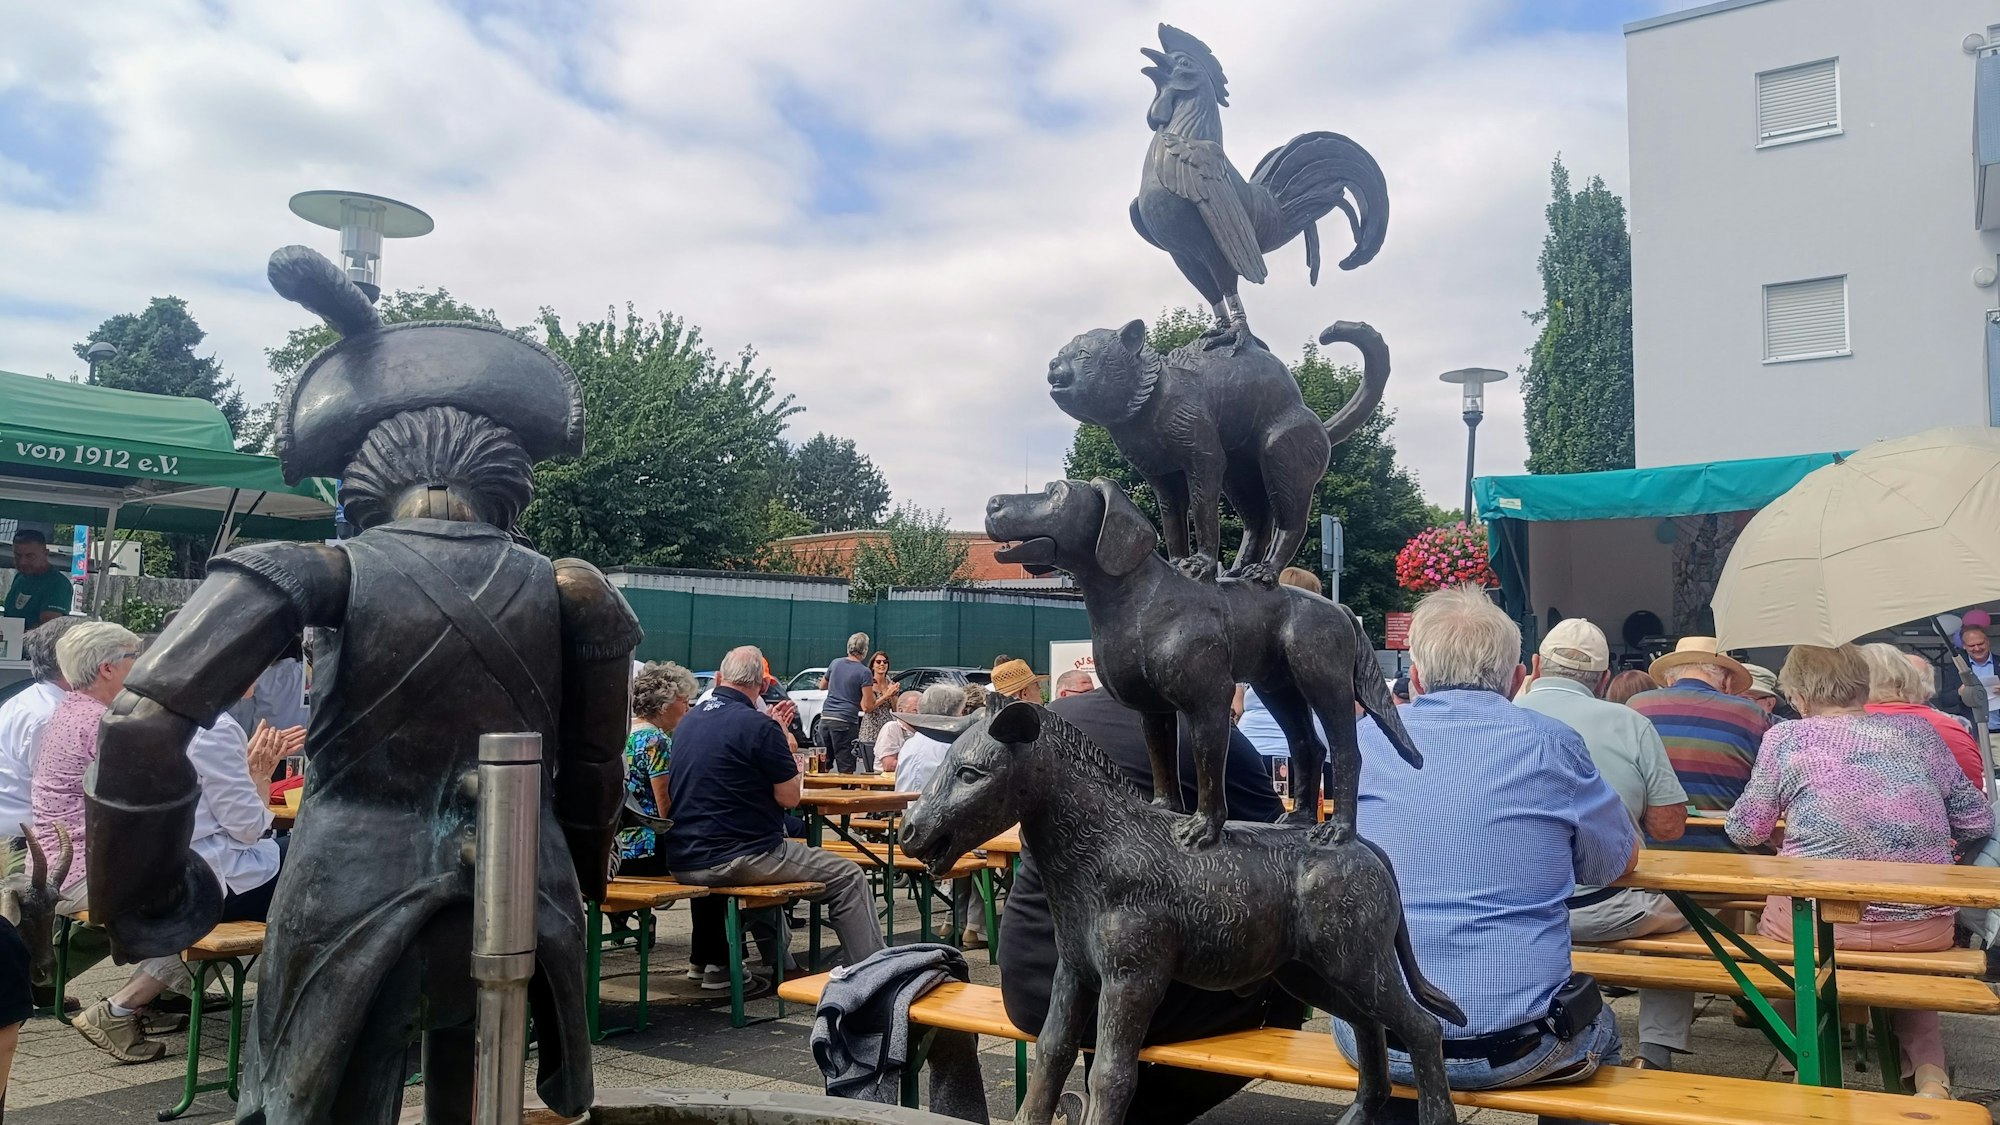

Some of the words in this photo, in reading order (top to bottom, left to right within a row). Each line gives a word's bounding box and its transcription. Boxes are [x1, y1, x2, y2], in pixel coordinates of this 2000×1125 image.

[16, 442, 66, 462] von
[74, 445, 130, 469] 1912
[138, 455, 178, 475] e.V.
[1074, 657, 1085, 669] DJ
